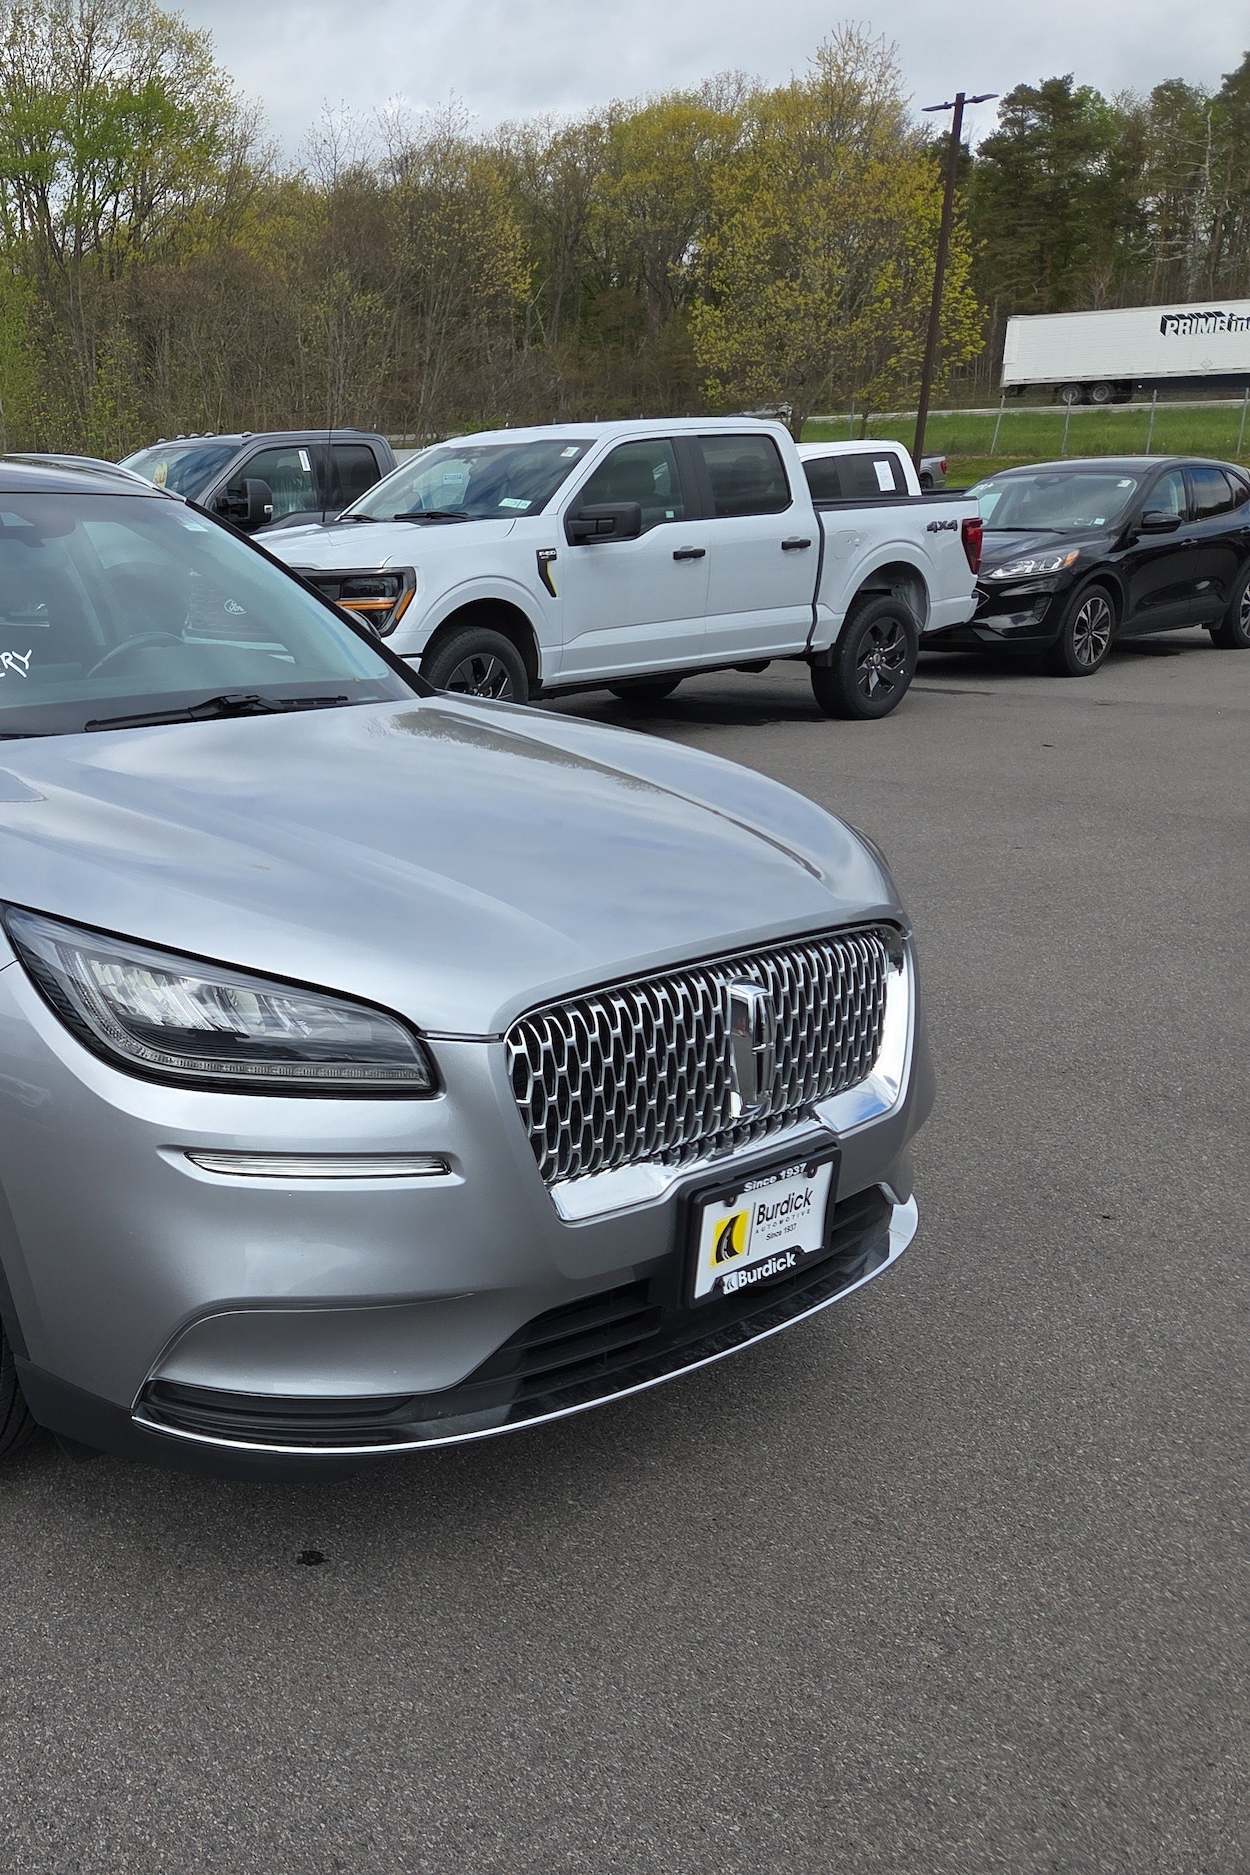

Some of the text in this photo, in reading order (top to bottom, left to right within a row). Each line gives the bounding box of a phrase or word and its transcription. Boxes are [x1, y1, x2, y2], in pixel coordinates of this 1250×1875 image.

[1160, 311, 1250, 336] PRIME in
[744, 1163, 807, 1192] Since 1937
[756, 1187, 814, 1226] Burdick
[755, 1209, 811, 1234] AUTOMOTIVE
[766, 1230, 782, 1241] Since
[737, 1252, 796, 1288] Burdick
